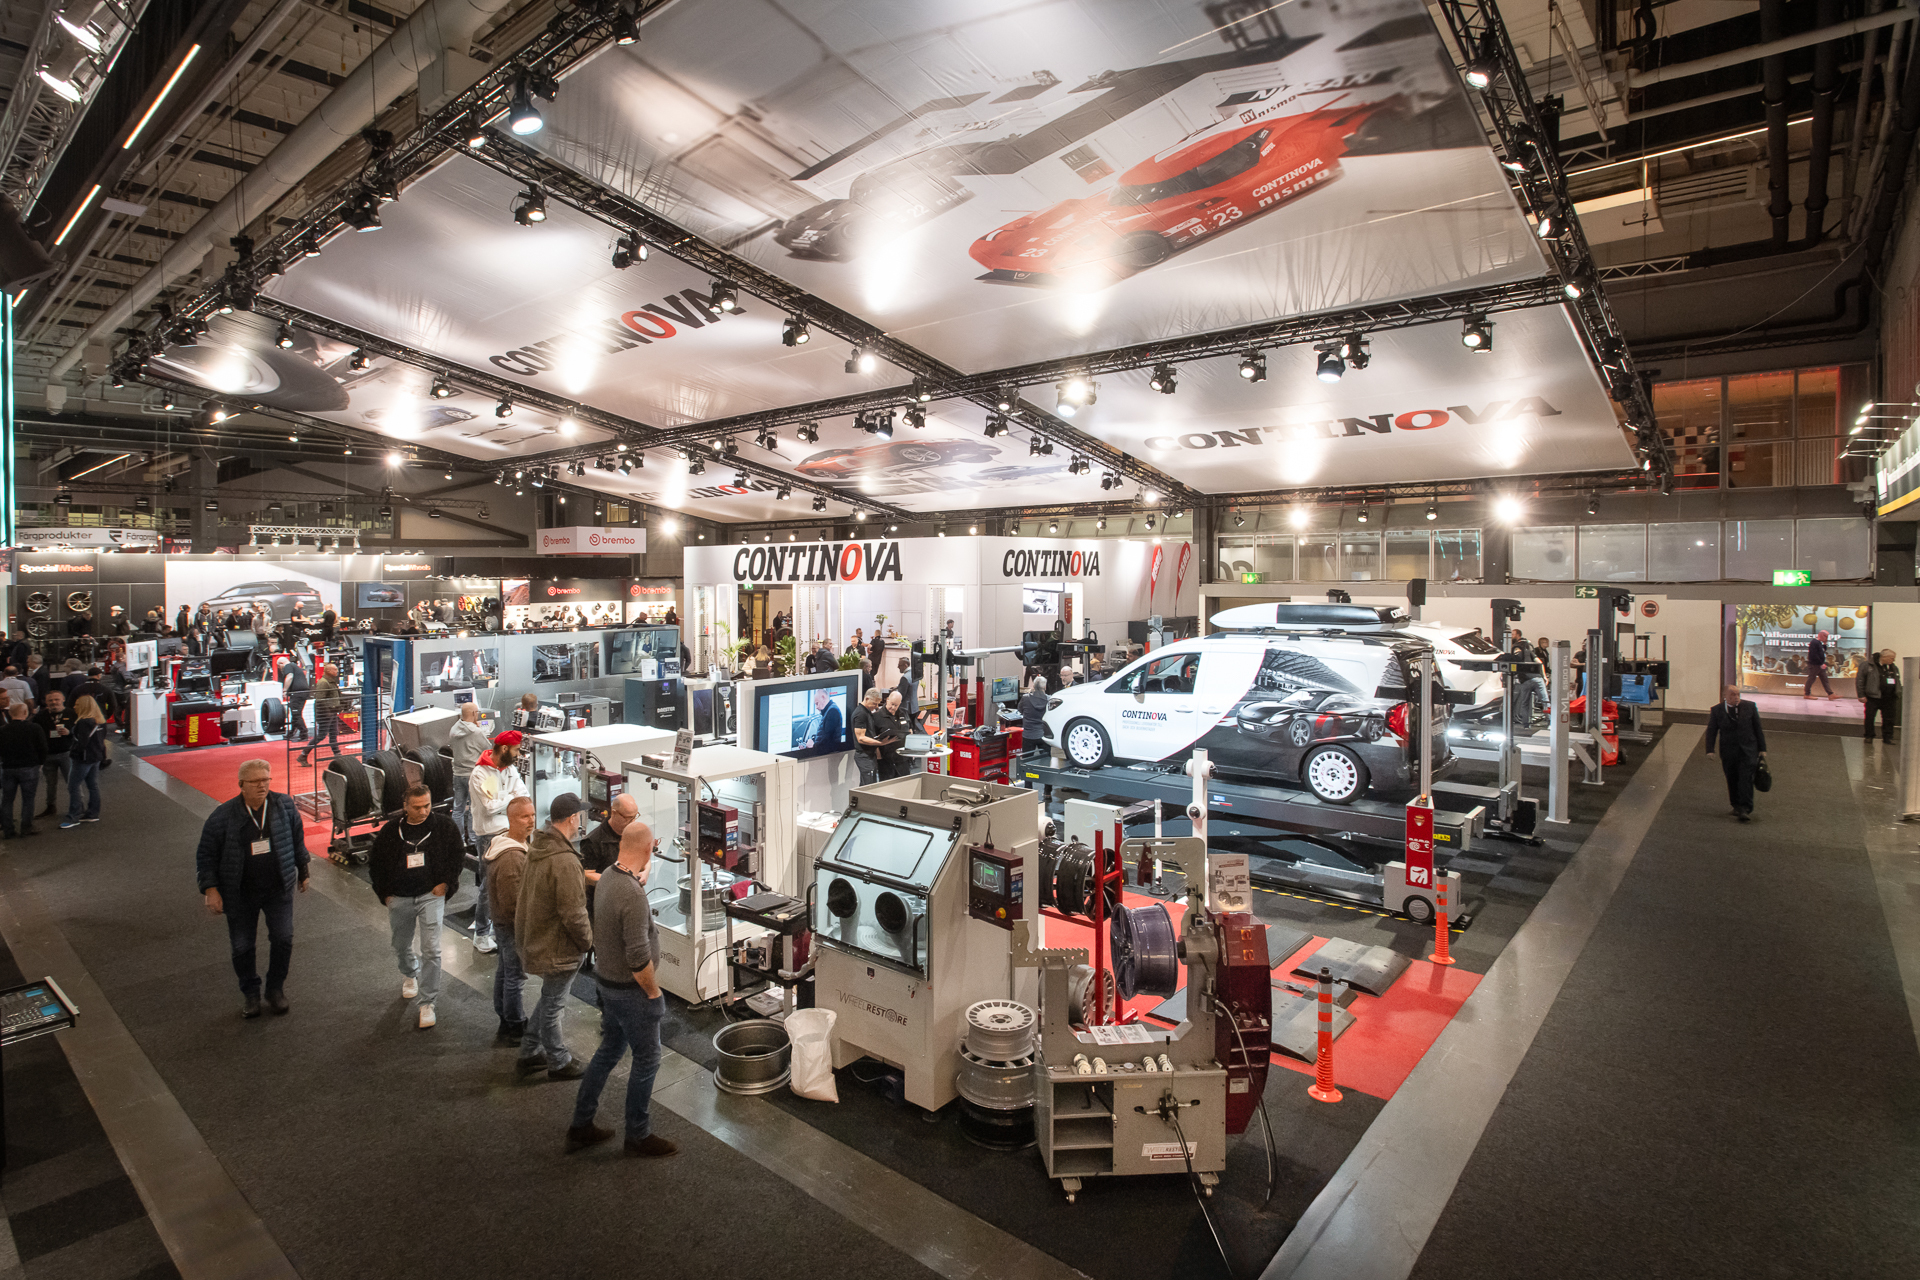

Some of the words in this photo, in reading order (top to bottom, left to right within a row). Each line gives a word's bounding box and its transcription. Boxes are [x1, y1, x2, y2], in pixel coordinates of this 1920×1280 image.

[1252, 157, 1324, 198] CONTINOVA
[1258, 168, 1330, 208] nismo
[1213, 206, 1243, 227] 23
[1190, 224, 1207, 236] P1
[1019, 248, 1049, 258] 23
[550, 536, 571, 545] brembo
[601, 536, 636, 545] brembo
[733, 541, 903, 582] CONTINOVA
[1003, 549, 1100, 577] CONTINOVA
[556, 587, 581, 595] brembo
[641, 586, 672, 595] brembo
[1122, 710, 1168, 721] CONTINOVA
[1560, 692, 1570, 724] CML
